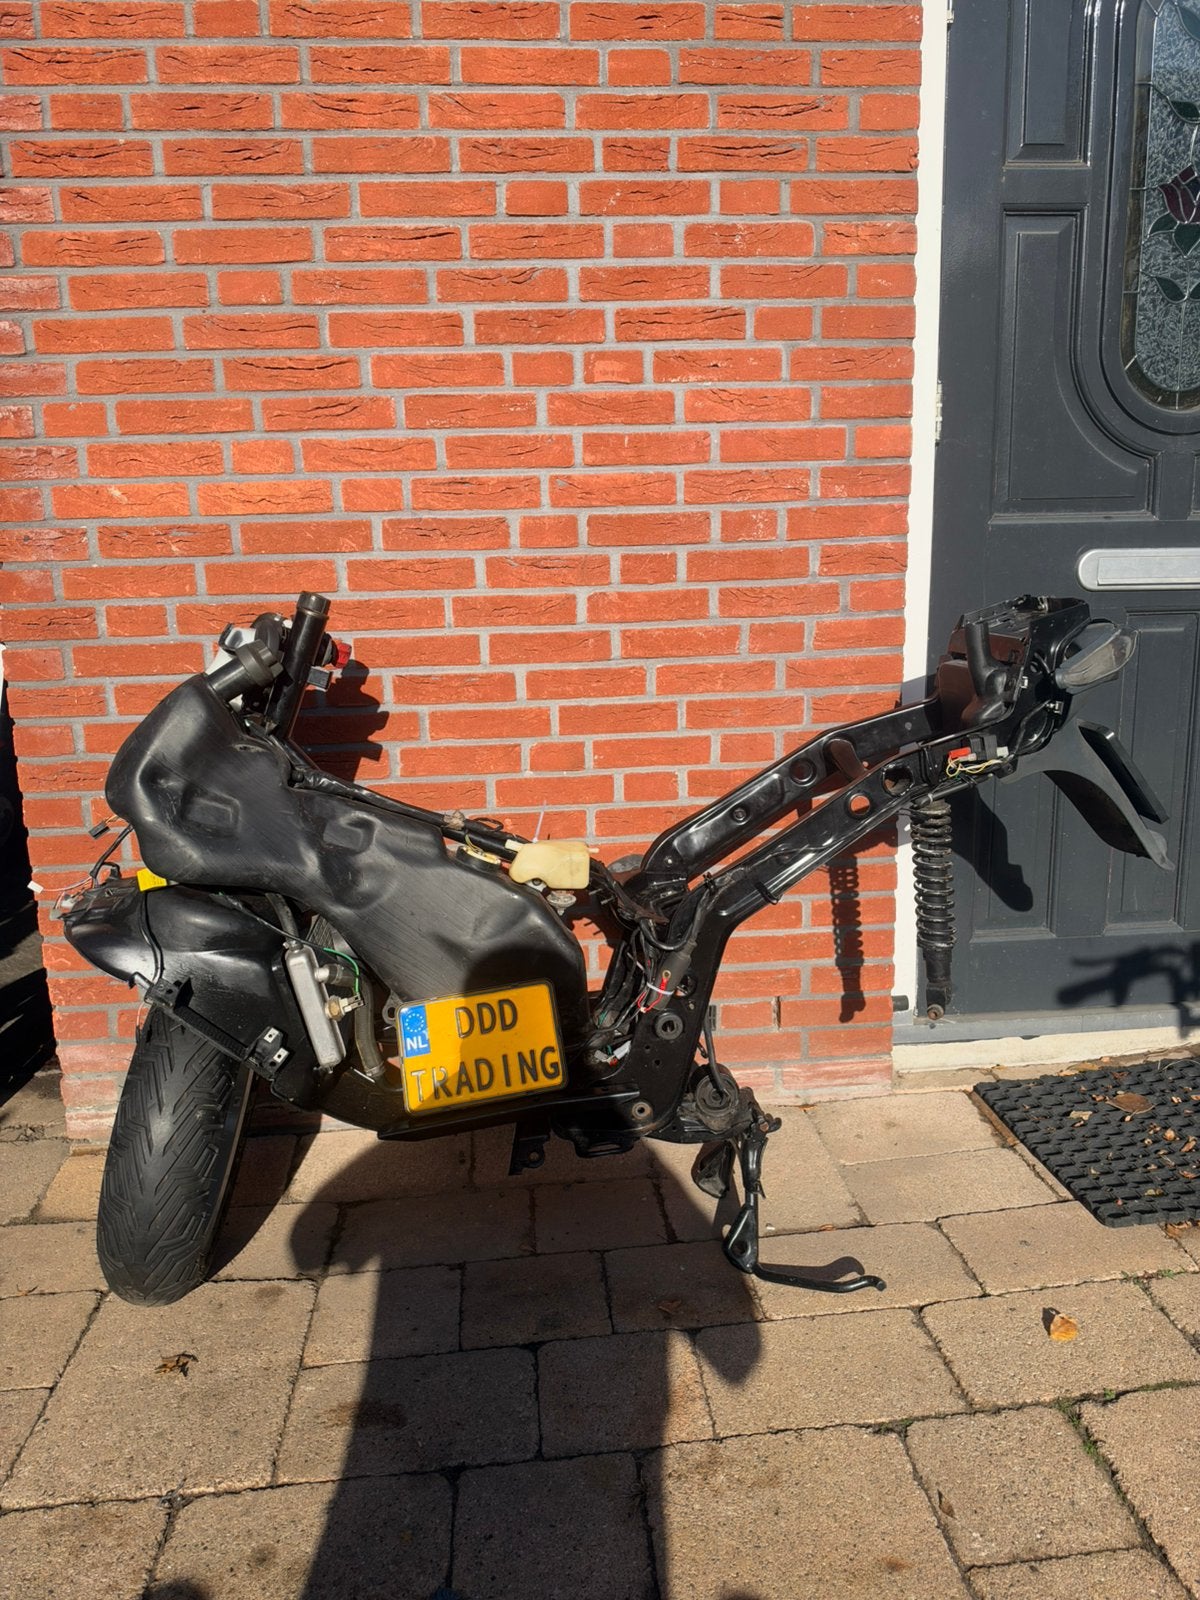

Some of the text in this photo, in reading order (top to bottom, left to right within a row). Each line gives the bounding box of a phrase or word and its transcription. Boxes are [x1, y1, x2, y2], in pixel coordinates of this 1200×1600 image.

[455, 999, 518, 1038] DDD
[406, 1036, 428, 1050] NL
[411, 1046, 560, 1102] TRADING
